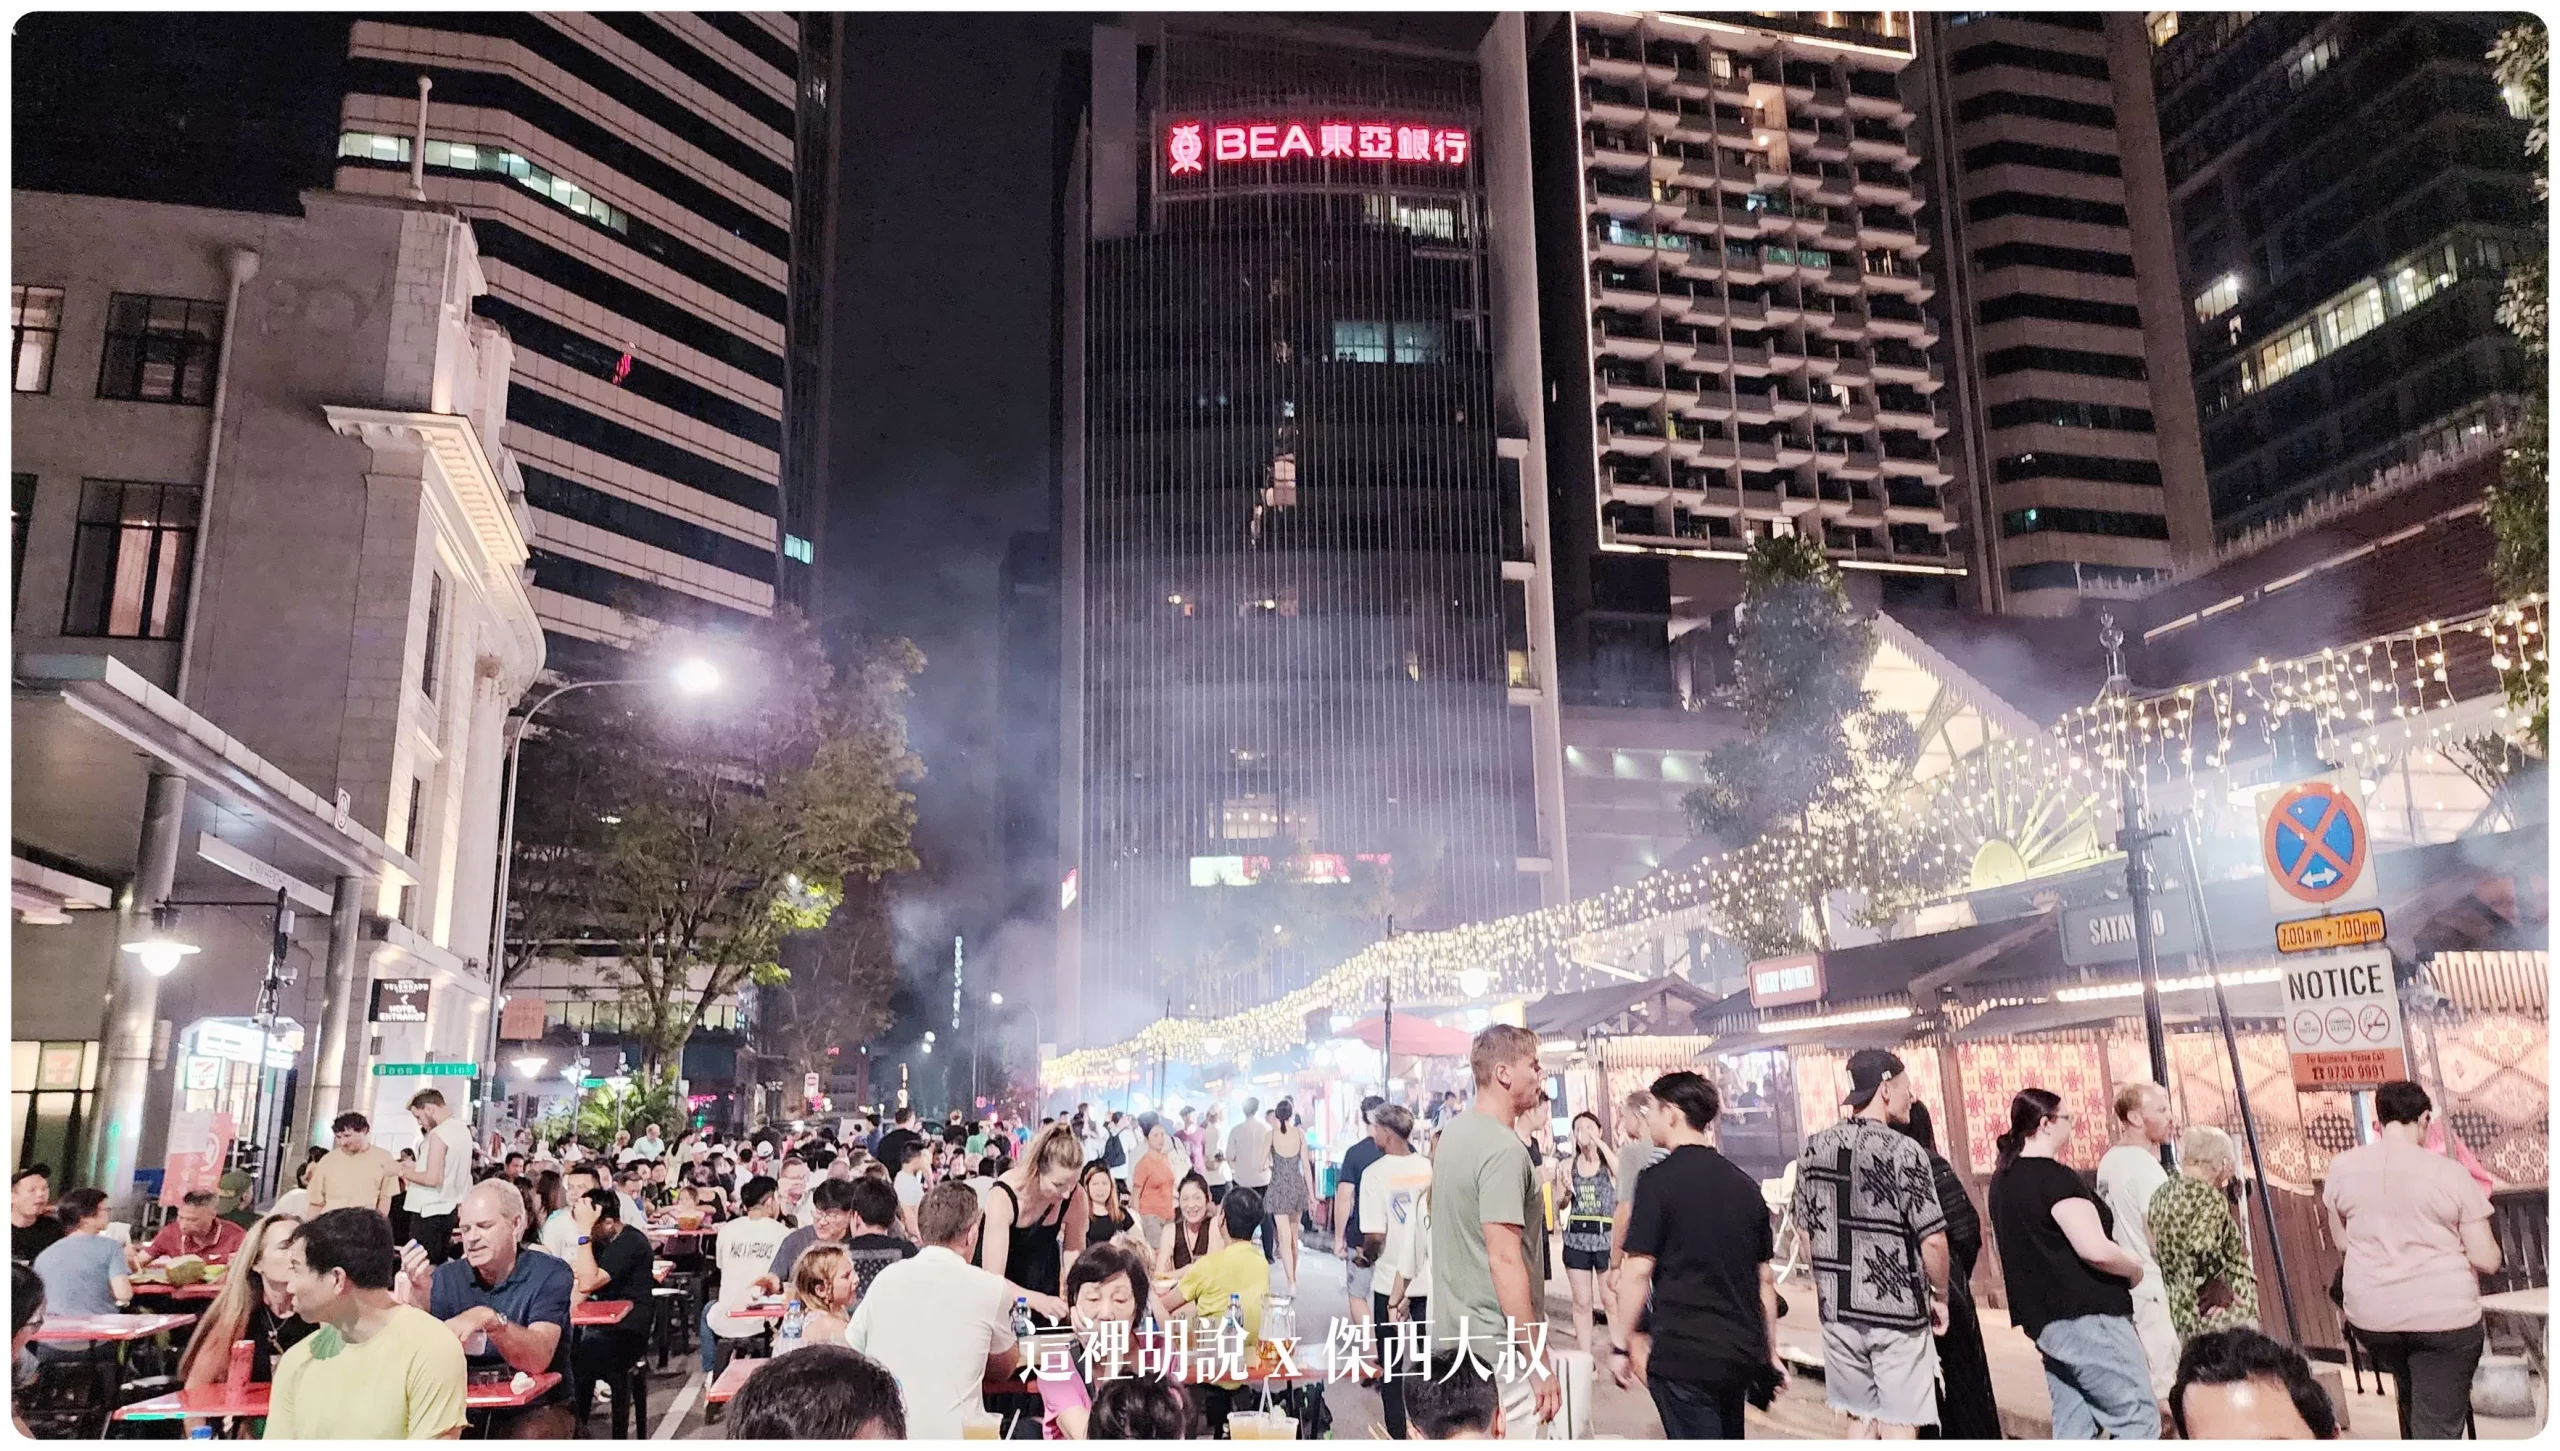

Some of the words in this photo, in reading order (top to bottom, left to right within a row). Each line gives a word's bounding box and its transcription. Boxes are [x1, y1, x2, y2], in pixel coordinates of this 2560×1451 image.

[1215, 125, 1314, 161] BEA
[1320, 123, 1468, 166] 東亞銀行
[2281, 925, 2323, 947] 7.00am
[2335, 918, 2381, 942] 7.00pm
[2287, 964, 2384, 1001] NOTICE
[379, 1011, 426, 1021] ENTRANCE
[388, 1004, 418, 1013] HOTEL
[379, 1065, 413, 1075] Boon
[445, 1064, 472, 1075] Link
